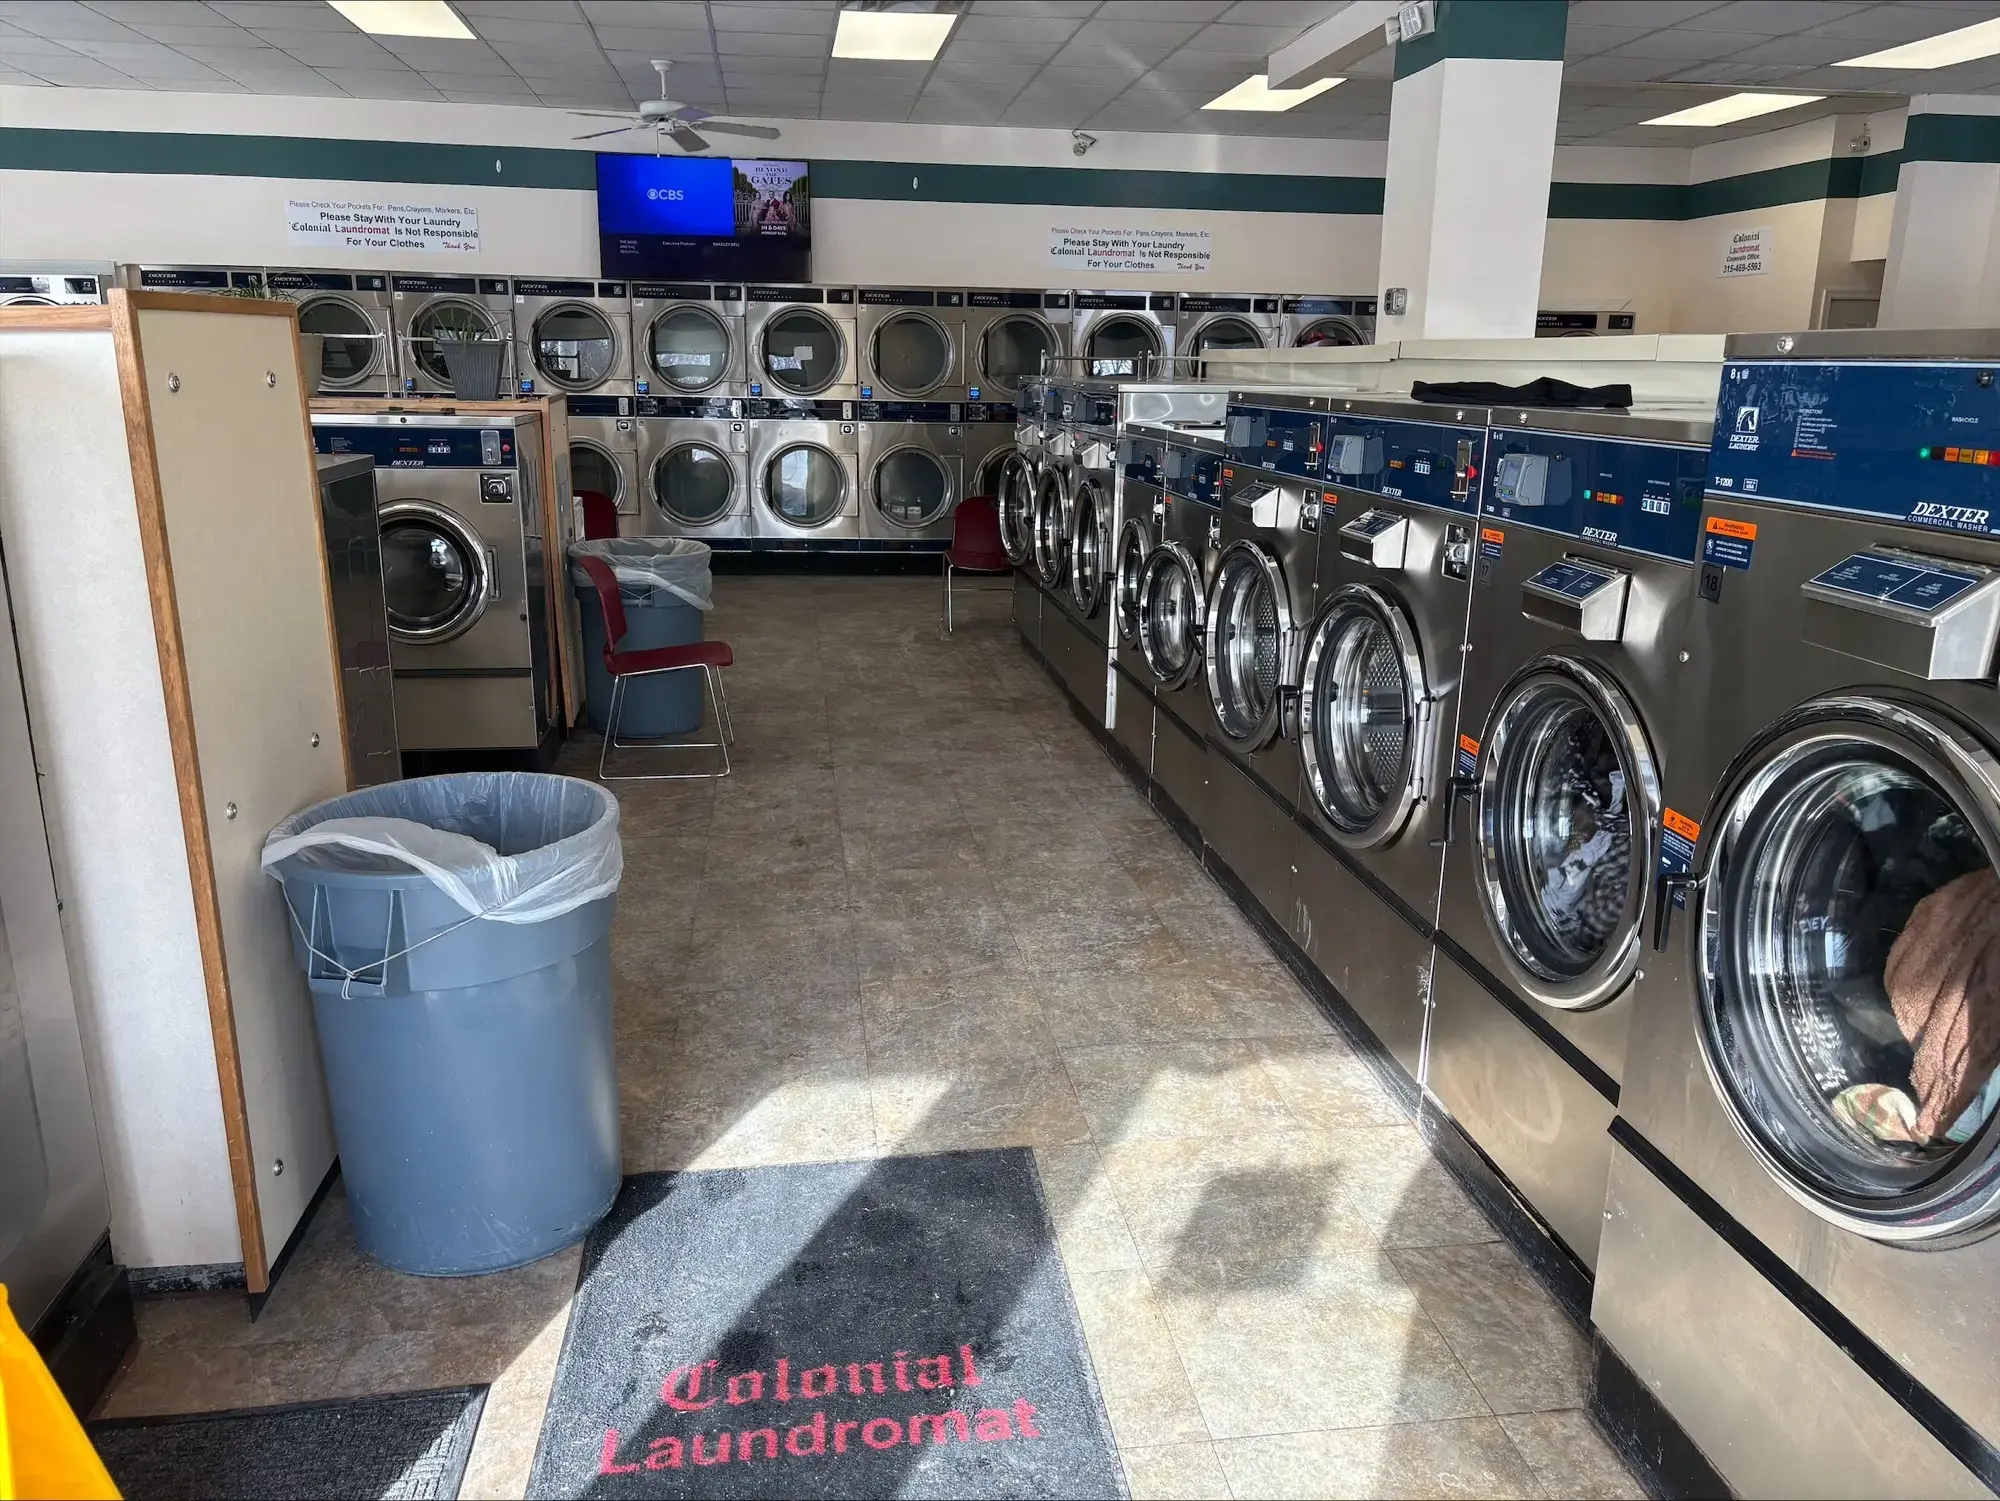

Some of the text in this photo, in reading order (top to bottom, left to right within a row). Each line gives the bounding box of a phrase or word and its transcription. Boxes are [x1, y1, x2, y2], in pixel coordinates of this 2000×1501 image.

[751, 176, 792, 184] GATES
[659, 189, 683, 200] CBS
[289, 200, 310, 208] Please
[311, 201, 331, 209] Check
[320, 212, 461, 228] Please Stay With Your Laundry
[291, 222, 479, 238] Colonial Laundromat Is Not Responsible
[347, 237, 425, 248] For Your Clothes
[1733, 232, 1759, 243] Colonial
[463, 242, 475, 251] You
[1063, 238, 1090, 246] Please
[1092, 239, 1110, 248] Stay
[1132, 240, 1151, 248] Your
[1153, 241, 1185, 251] Laundry
[1729, 244, 1760, 254] Laundromat
[1050, 246, 1085, 255] Colonial
[1087, 248, 1135, 257] Laundromat
[1139, 250, 1146, 258] Is
[1163, 251, 1210, 260] Responsible
[1103, 260, 1122, 268] Your
[1124, 260, 1155, 269] Clothes
[1726, 255, 1746, 263] Corporate
[1729, 434, 1759, 444] DEXTER
[1728, 443, 1759, 451] LAUNDRY
[1382, 486, 1403, 497] DEXTER
[1911, 501, 1989, 524] DEXTER
[1907, 515, 1988, 532] COMMERCIAL WASHER
[1582, 526, 1618, 542] DEXTER
[1482, 564, 1489, 577] 17
[1705, 573, 1718, 591] 18
[659, 1343, 983, 1412] Colonial
[600, 1396, 1041, 1474] Laundromat
